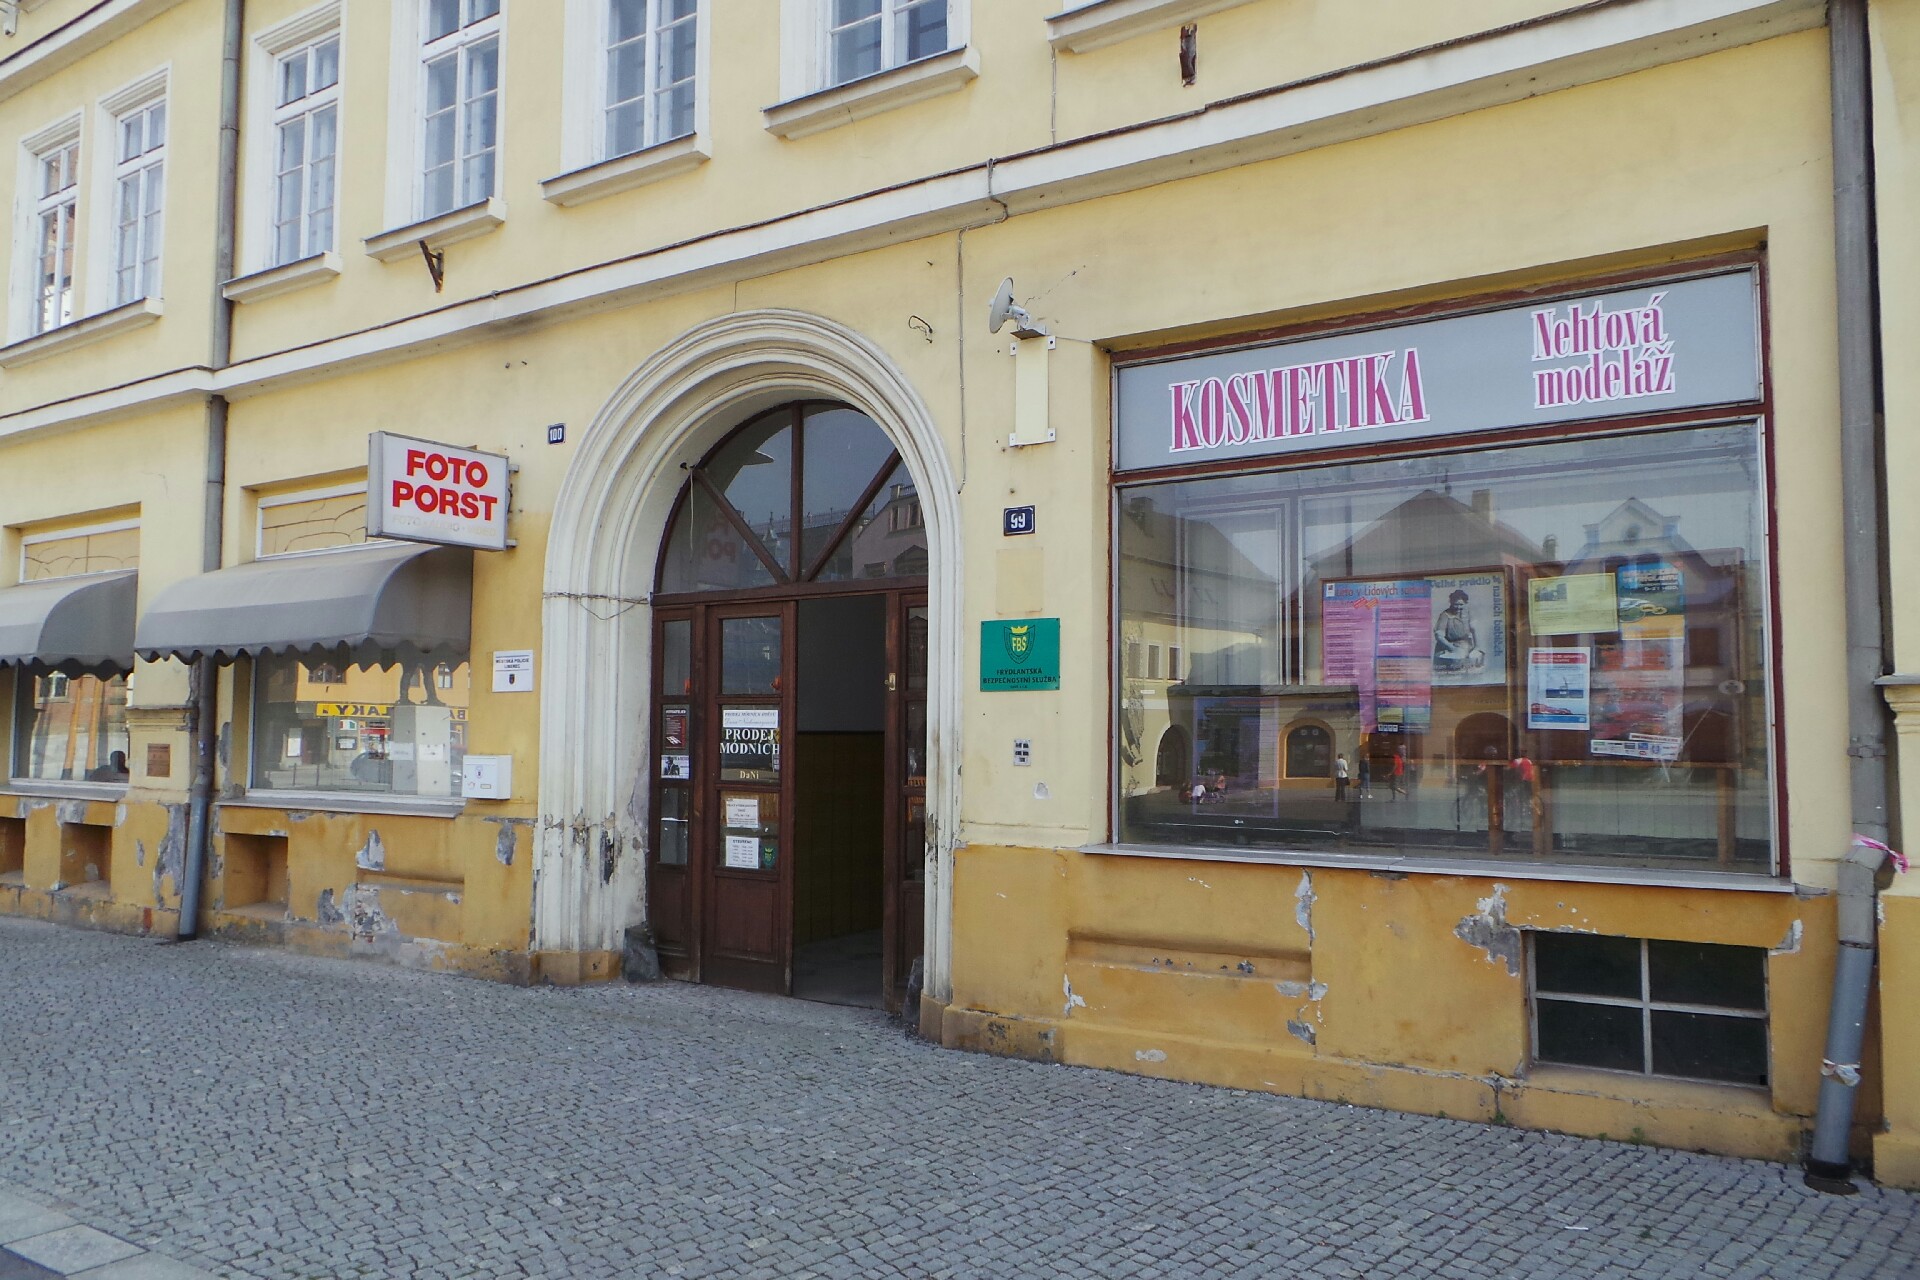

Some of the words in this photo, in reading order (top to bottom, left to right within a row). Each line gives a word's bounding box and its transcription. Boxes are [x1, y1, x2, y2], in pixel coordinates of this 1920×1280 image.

[1531, 291, 1669, 361] Nehtová
[1533, 341, 1675, 409] modeláž
[1169, 348, 1430, 453] KOSMETIKA
[550, 428, 563, 441] 100
[407, 449, 488, 488] FOTO
[392, 480, 498, 521] PORST
[1010, 512, 1026, 529] 99
[1012, 636, 1027, 652] FBS
[983, 676, 1031, 684] BEZPEČNOSTNÍ
[1032, 675, 1057, 683] SLUŽBA
[725, 728, 774, 741] PRODEJ
[719, 739, 780, 755] MÓDNÍCH
